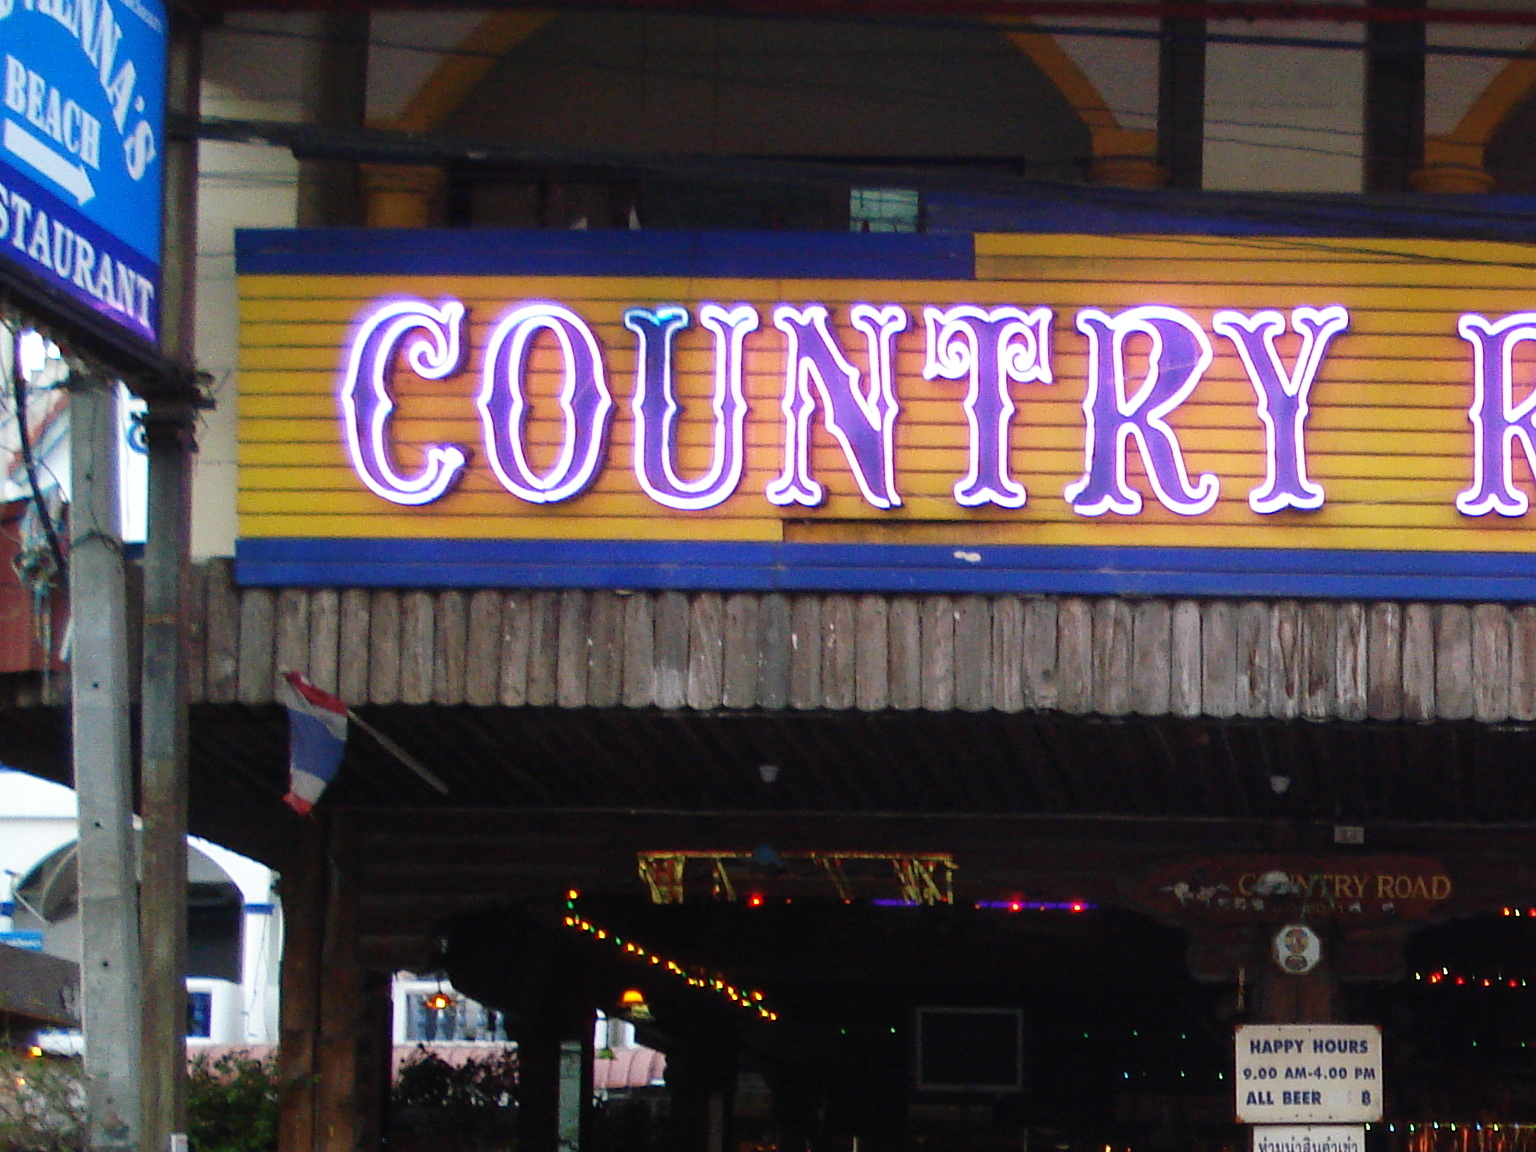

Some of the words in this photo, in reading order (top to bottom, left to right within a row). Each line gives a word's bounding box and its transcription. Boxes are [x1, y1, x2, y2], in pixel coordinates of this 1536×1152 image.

[5, 53, 101, 171] BEACH
[339, 299, 1350, 518] COUNTRY
[1377, 874, 1453, 900] ROAD
[1249, 1039, 1304, 1054] HAPPY
[1312, 1039, 1369, 1054] HOURS
[1243, 1067, 1278, 1081] 9.00
[1354, 1067, 1376, 1080] PM
[1246, 1091, 1274, 1106] ALL
[1282, 1091, 1322, 1105] BEER
